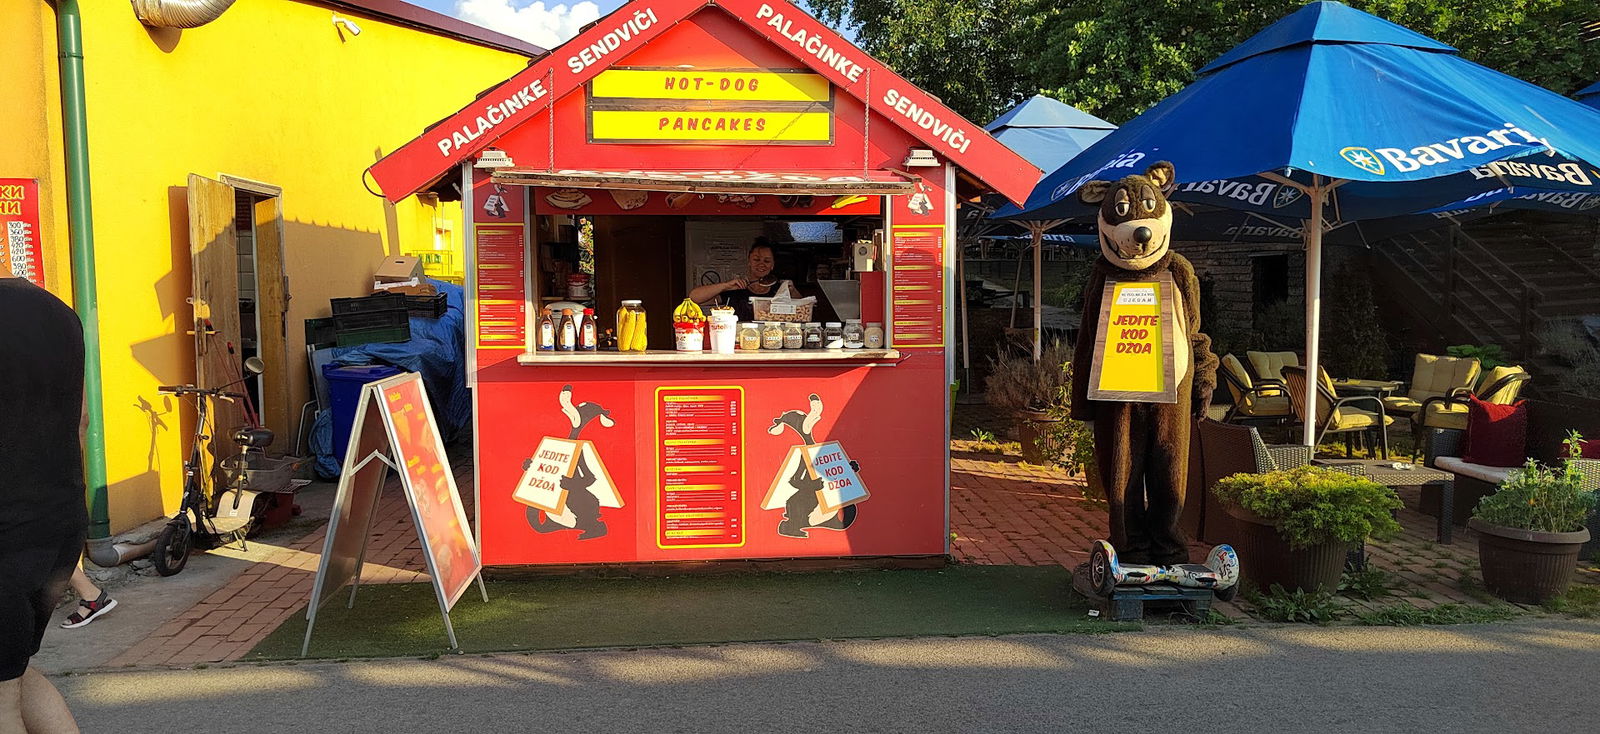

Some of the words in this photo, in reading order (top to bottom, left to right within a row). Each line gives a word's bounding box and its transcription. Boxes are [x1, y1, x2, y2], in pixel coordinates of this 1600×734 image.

[567, 7, 658, 75] SENDVIČI
[756, 3, 864, 83] PALAČINKE
[664, 76, 760, 92] HOT-DOG
[437, 78, 547, 157] PALAČINKE
[658, 117, 766, 132] PANCAKES
[882, 88, 971, 154] SENDVIČI
[1375, 122, 1557, 173] Bavari
[1113, 315, 1160, 326] JEDITE
[1120, 328, 1148, 340] KOD
[538, 449, 570, 464] JEDITE
[814, 452, 842, 466] JEDITE
[536, 463, 560, 474] KOD
[824, 466, 844, 477] KOD
[528, 476, 556, 492] DŽOA
[828, 478, 852, 491] DŽOA
